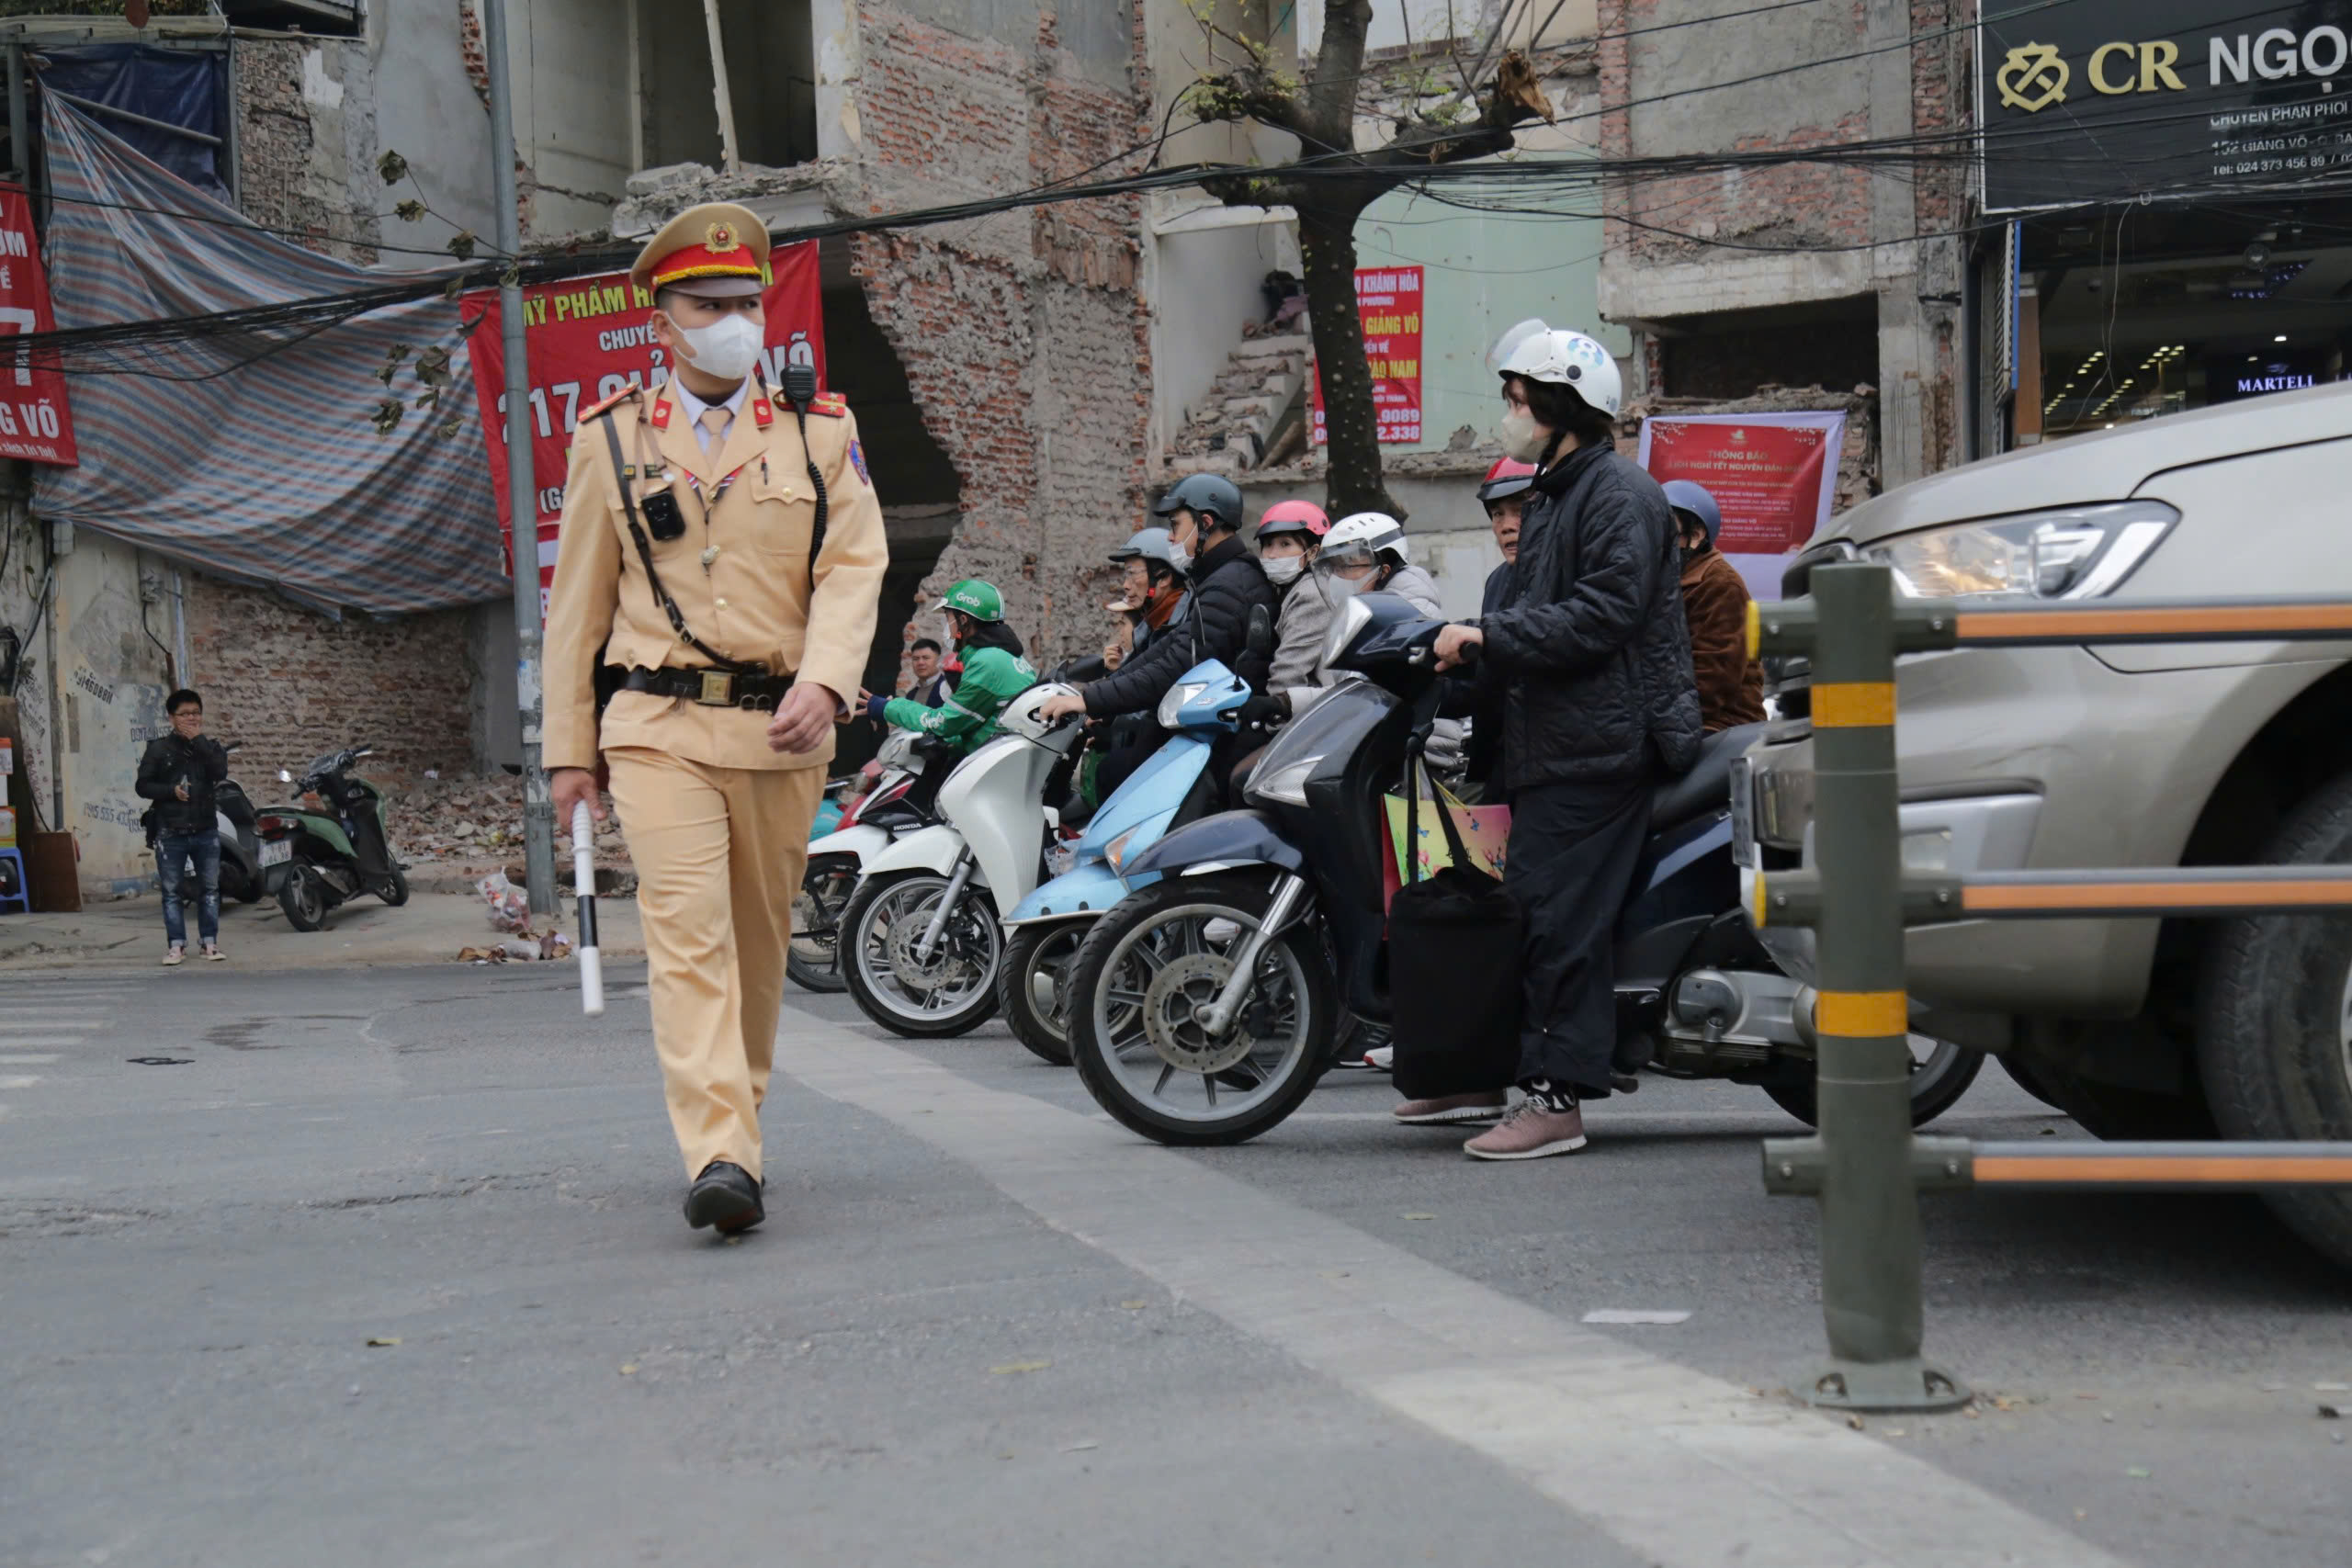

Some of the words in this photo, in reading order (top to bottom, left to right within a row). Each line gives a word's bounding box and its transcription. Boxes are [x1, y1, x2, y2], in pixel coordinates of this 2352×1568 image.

[2087, 40, 2187, 95] CR
[2209, 25, 2352, 94] NGỌ
[2236, 162, 2258, 174] 024
[2261, 160, 2283, 172] 373
[2286, 158, 2307, 169] 456
[2311, 156, 2325, 167] 89
[1363, 271, 1397, 293] KHÁNH
[554, 279, 628, 321] PHẨM
[632, 283, 656, 310] H
[1365, 309, 1401, 335] GIẢNG
[1389, 359, 1419, 379] NAM
[2238, 375, 2315, 393] MARTELL
[18, 398, 60, 439] VÕ
[956, 592, 981, 608] Grab
[893, 822, 922, 831] HONDA
